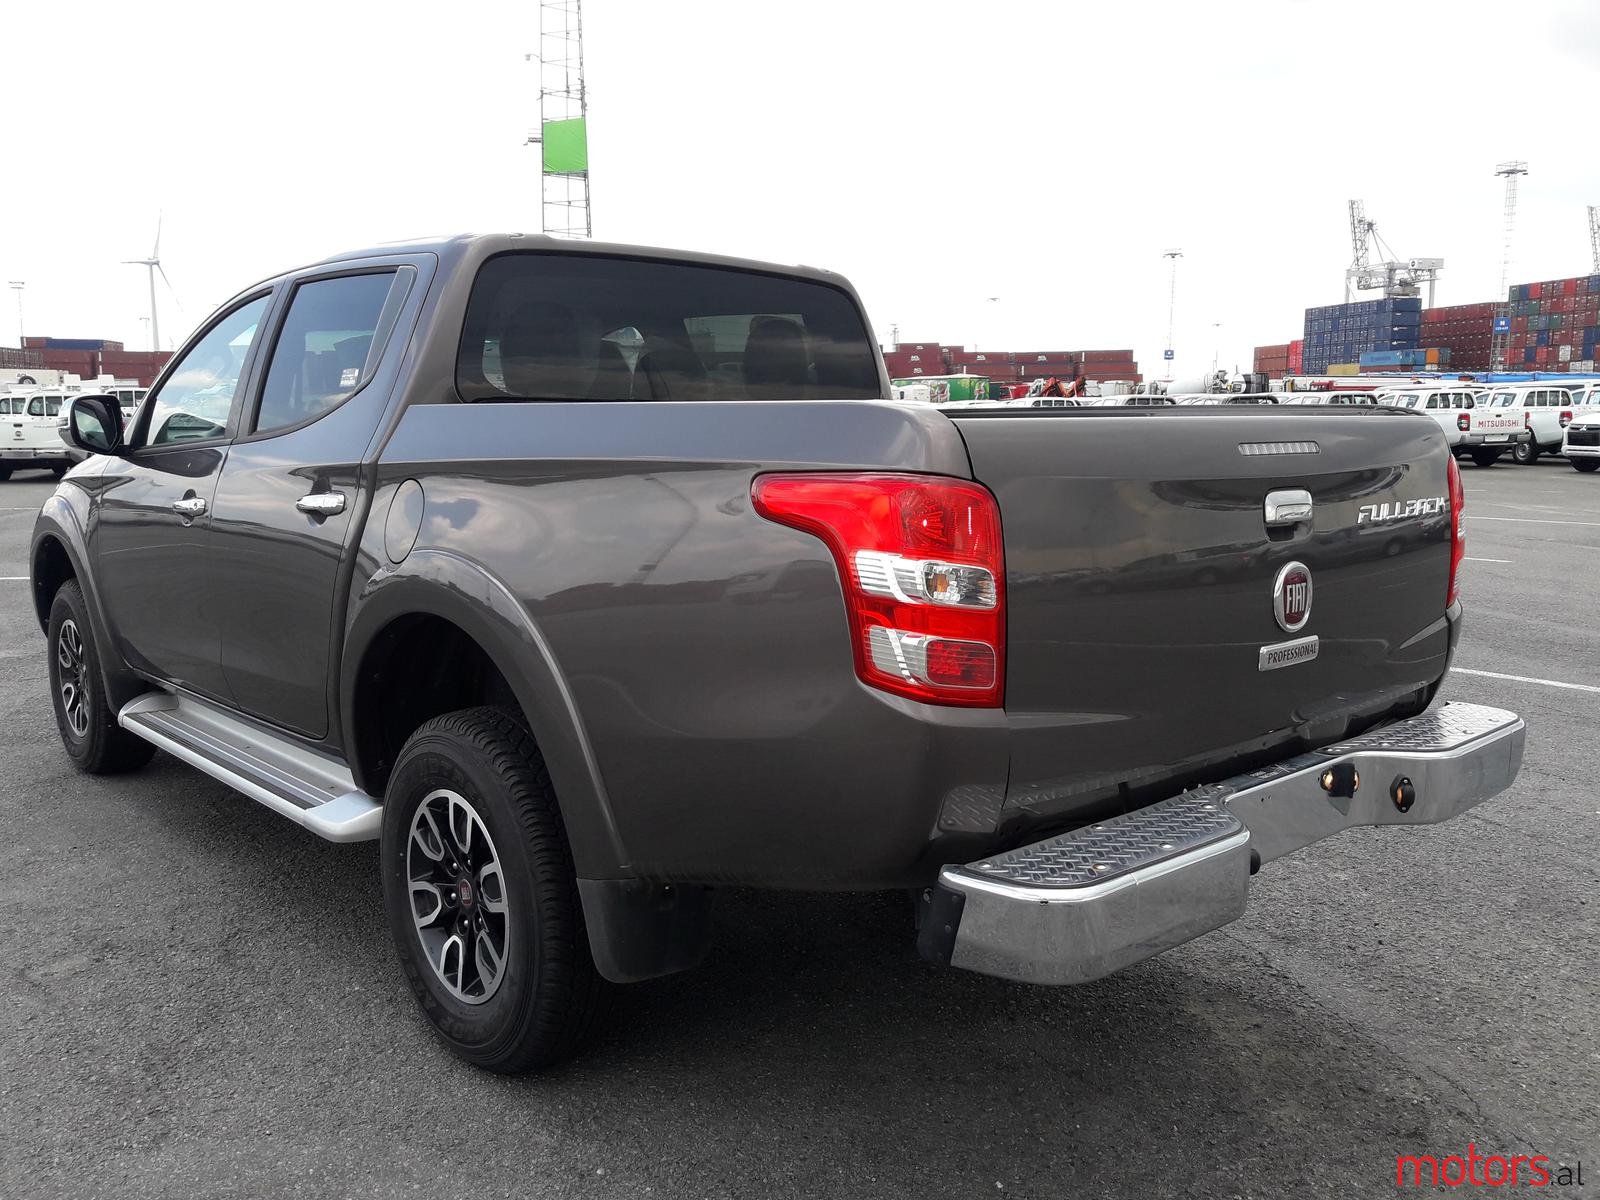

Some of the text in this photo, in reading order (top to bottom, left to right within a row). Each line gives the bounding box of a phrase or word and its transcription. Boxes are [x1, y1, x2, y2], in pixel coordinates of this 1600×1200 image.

[1477, 419, 1519, 429] MITSUBISHI
[1357, 497, 1446, 523] FULLBACK
[1285, 582, 1307, 614] FIAT
[1267, 643, 1317, 664] PROFESSIONAL
